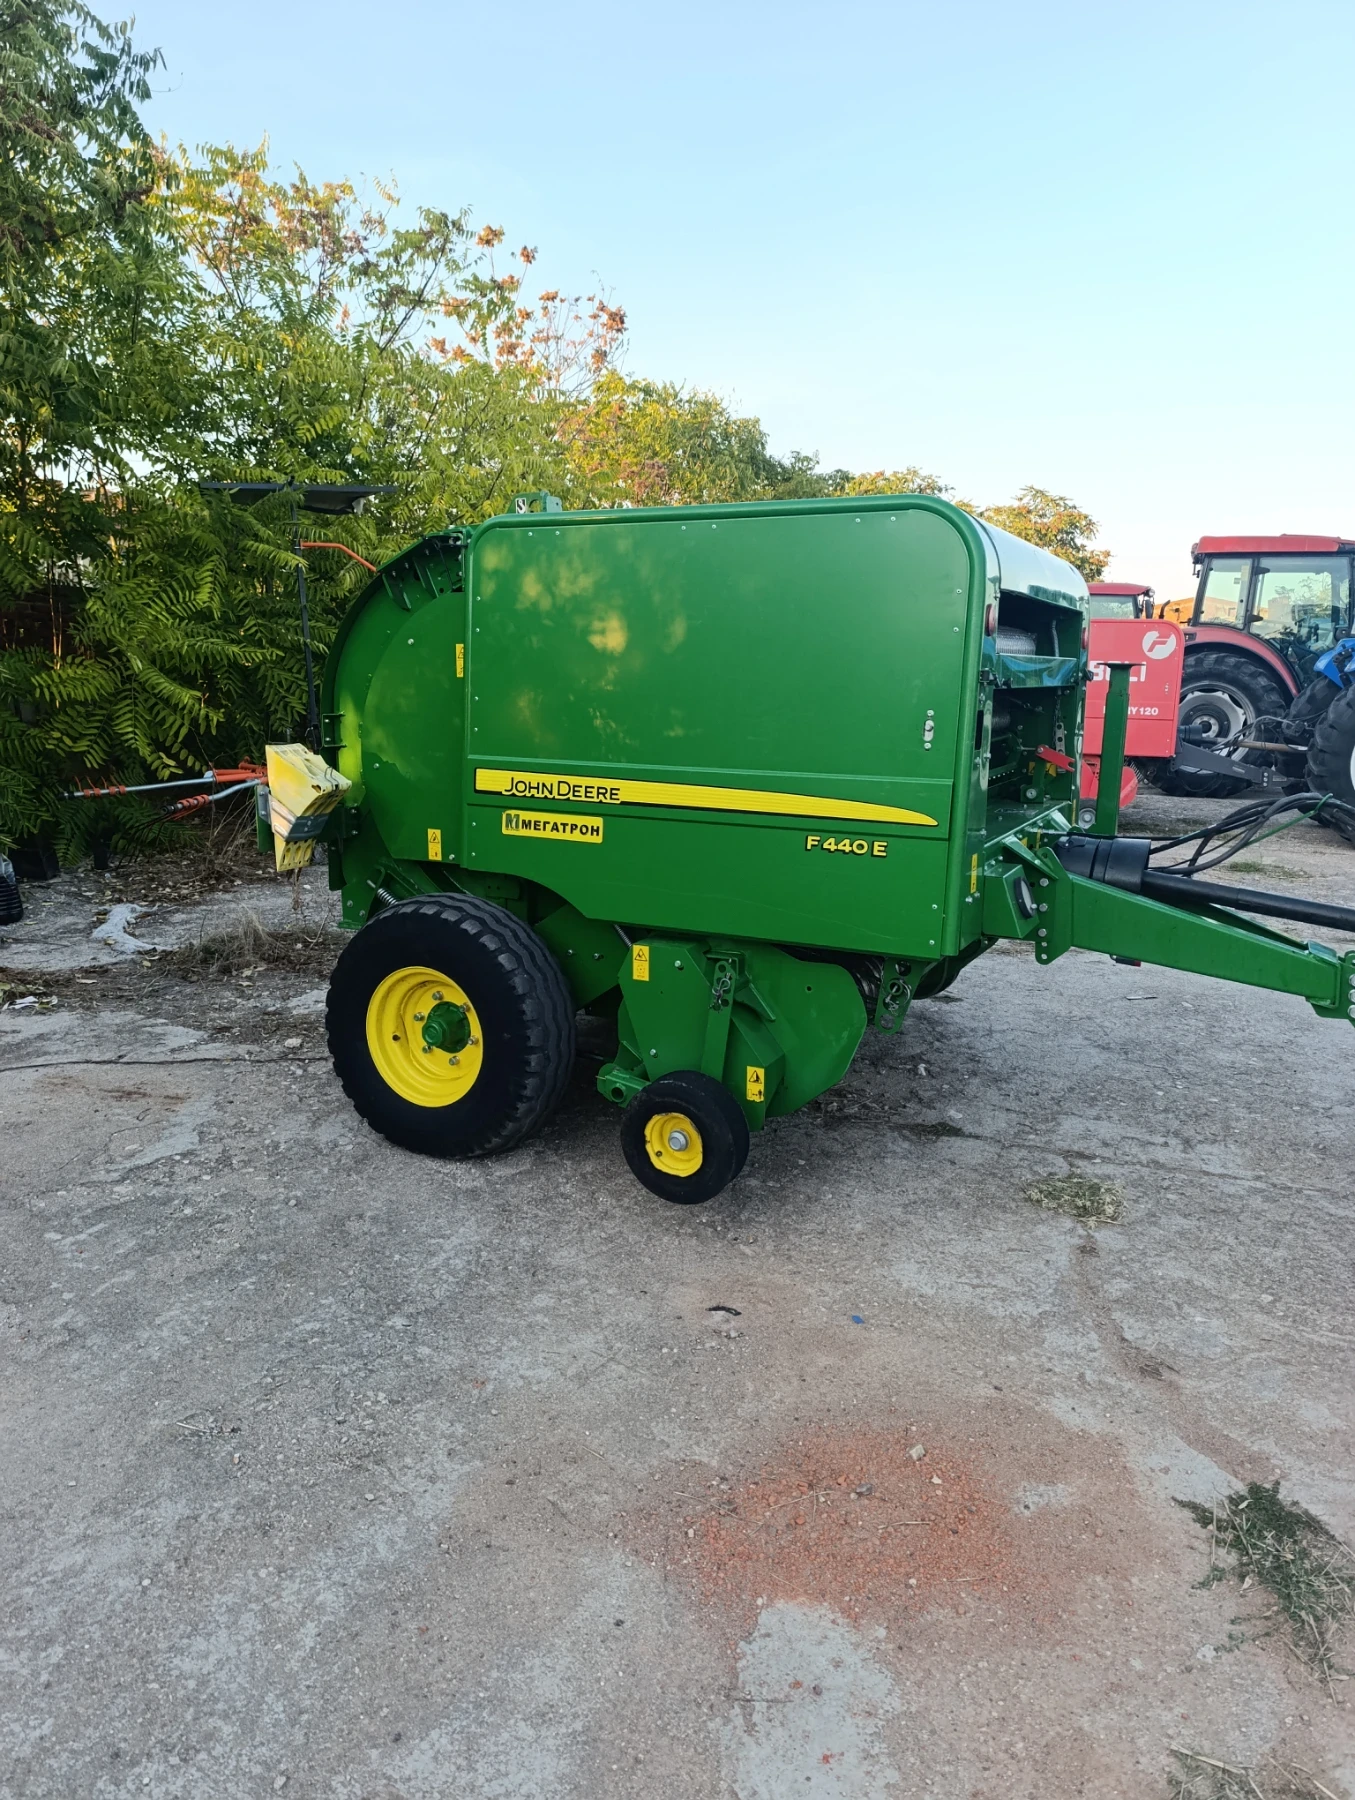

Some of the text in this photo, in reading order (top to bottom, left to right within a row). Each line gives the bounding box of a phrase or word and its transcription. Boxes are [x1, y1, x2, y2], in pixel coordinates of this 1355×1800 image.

[1139, 707, 1159, 716] 120
[504, 777, 621, 801] JOHN DEERE
[521, 819, 600, 837] МЕГАТРОН
[806, 835, 888, 857] F 440 E
